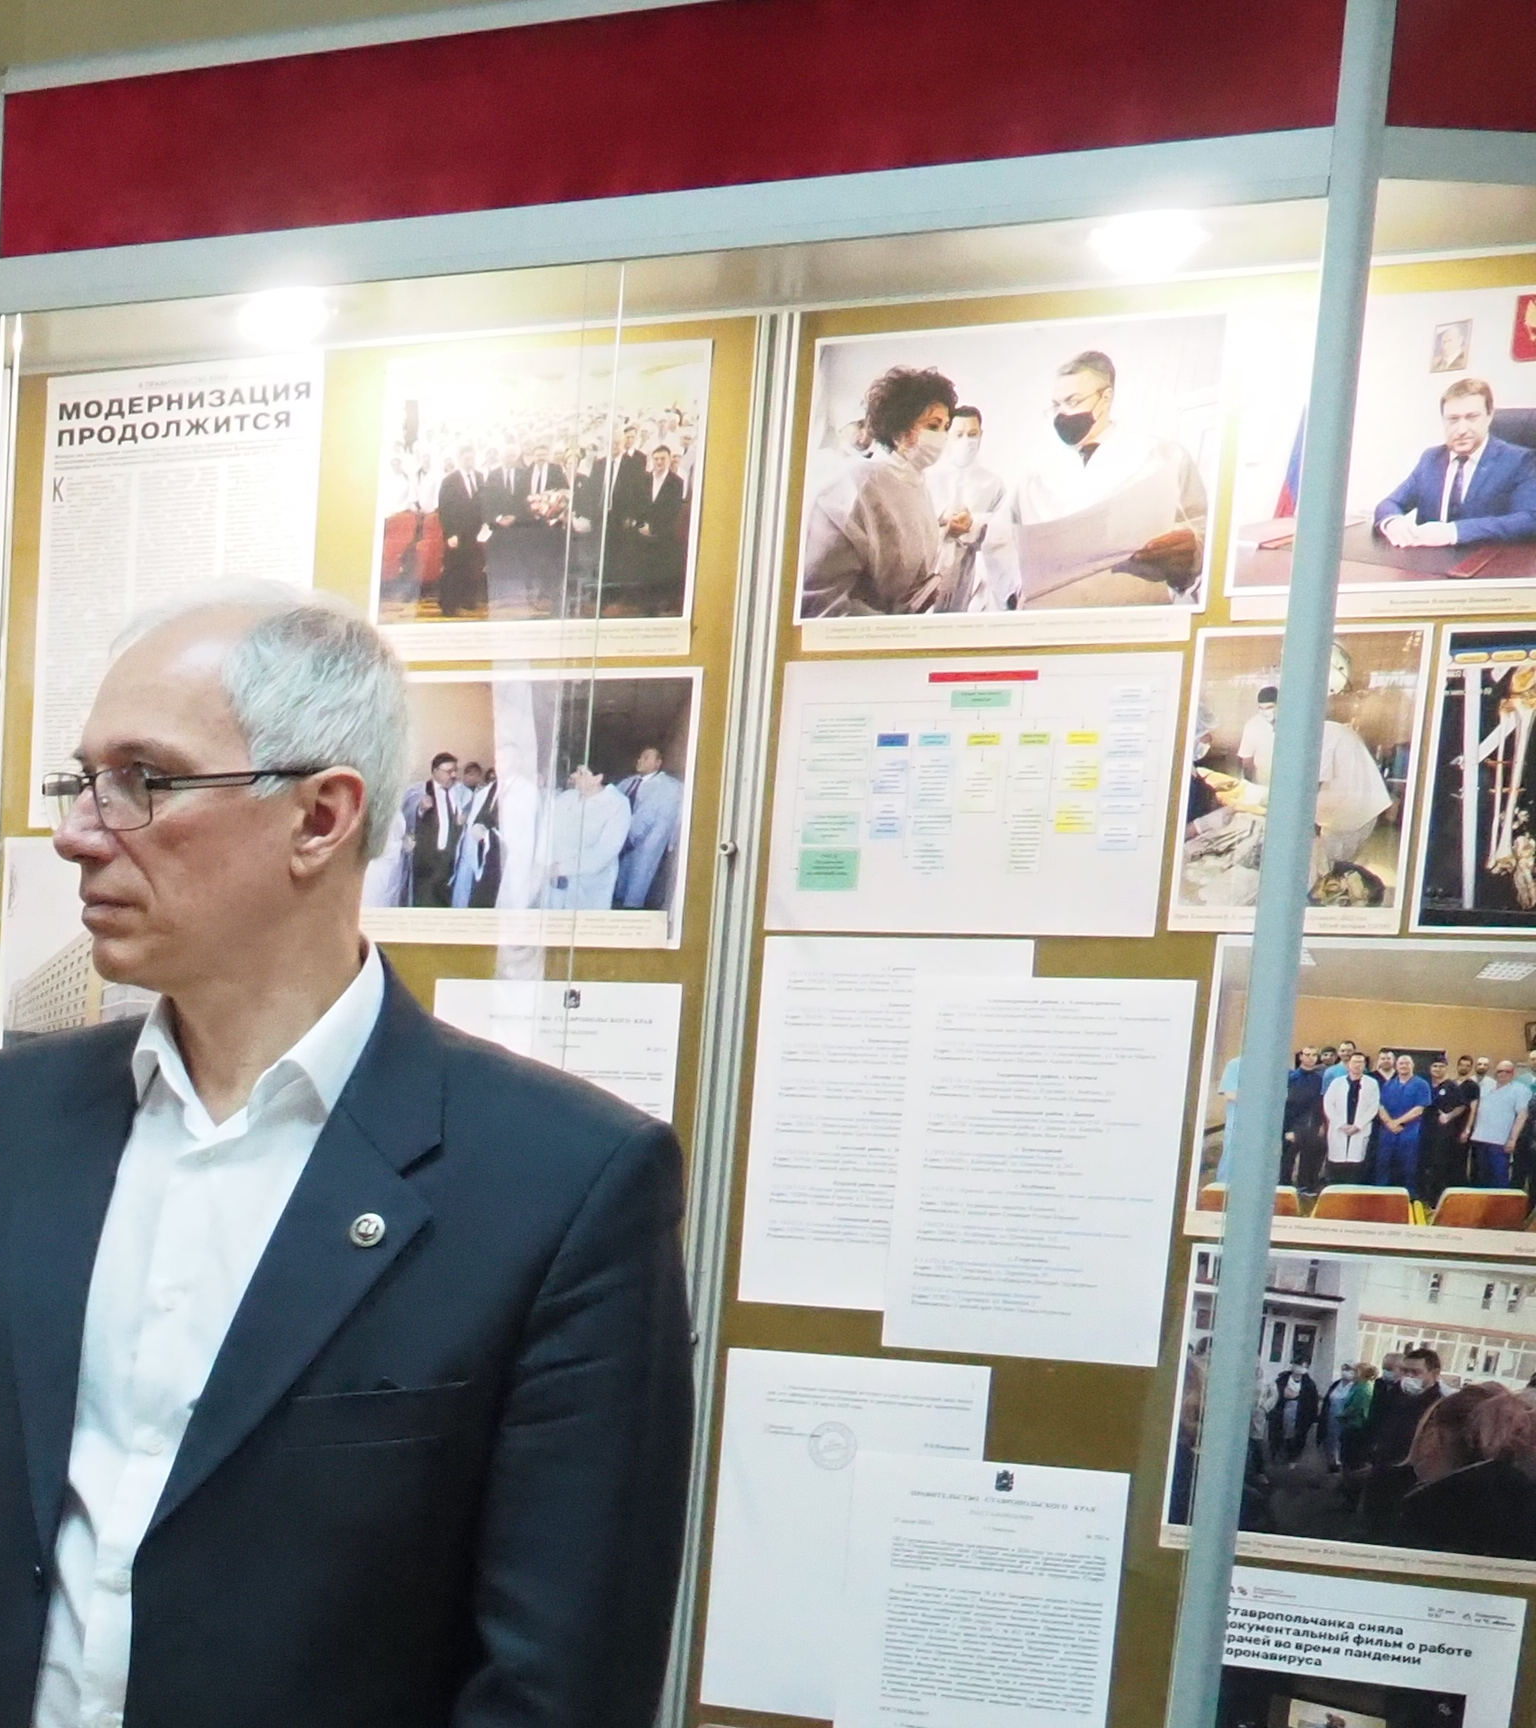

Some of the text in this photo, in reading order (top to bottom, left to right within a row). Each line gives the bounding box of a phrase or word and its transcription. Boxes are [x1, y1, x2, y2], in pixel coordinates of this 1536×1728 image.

[58, 381, 312, 421] МОДЕРНИЗАЦИЯ
[57, 410, 291, 447] ПРОДОЛЖИТСЯ
[1358, 1622, 1404, 1637] сняла
[1225, 1646, 1322, 1667] оронавируса
[1274, 1639, 1292, 1649] во
[1294, 1642, 1341, 1656] время
[1344, 1648, 1422, 1666] пандемии
[1352, 1634, 1403, 1651] фильм
[1406, 1642, 1415, 1650] о
[1418, 1642, 1473, 1659] работе
